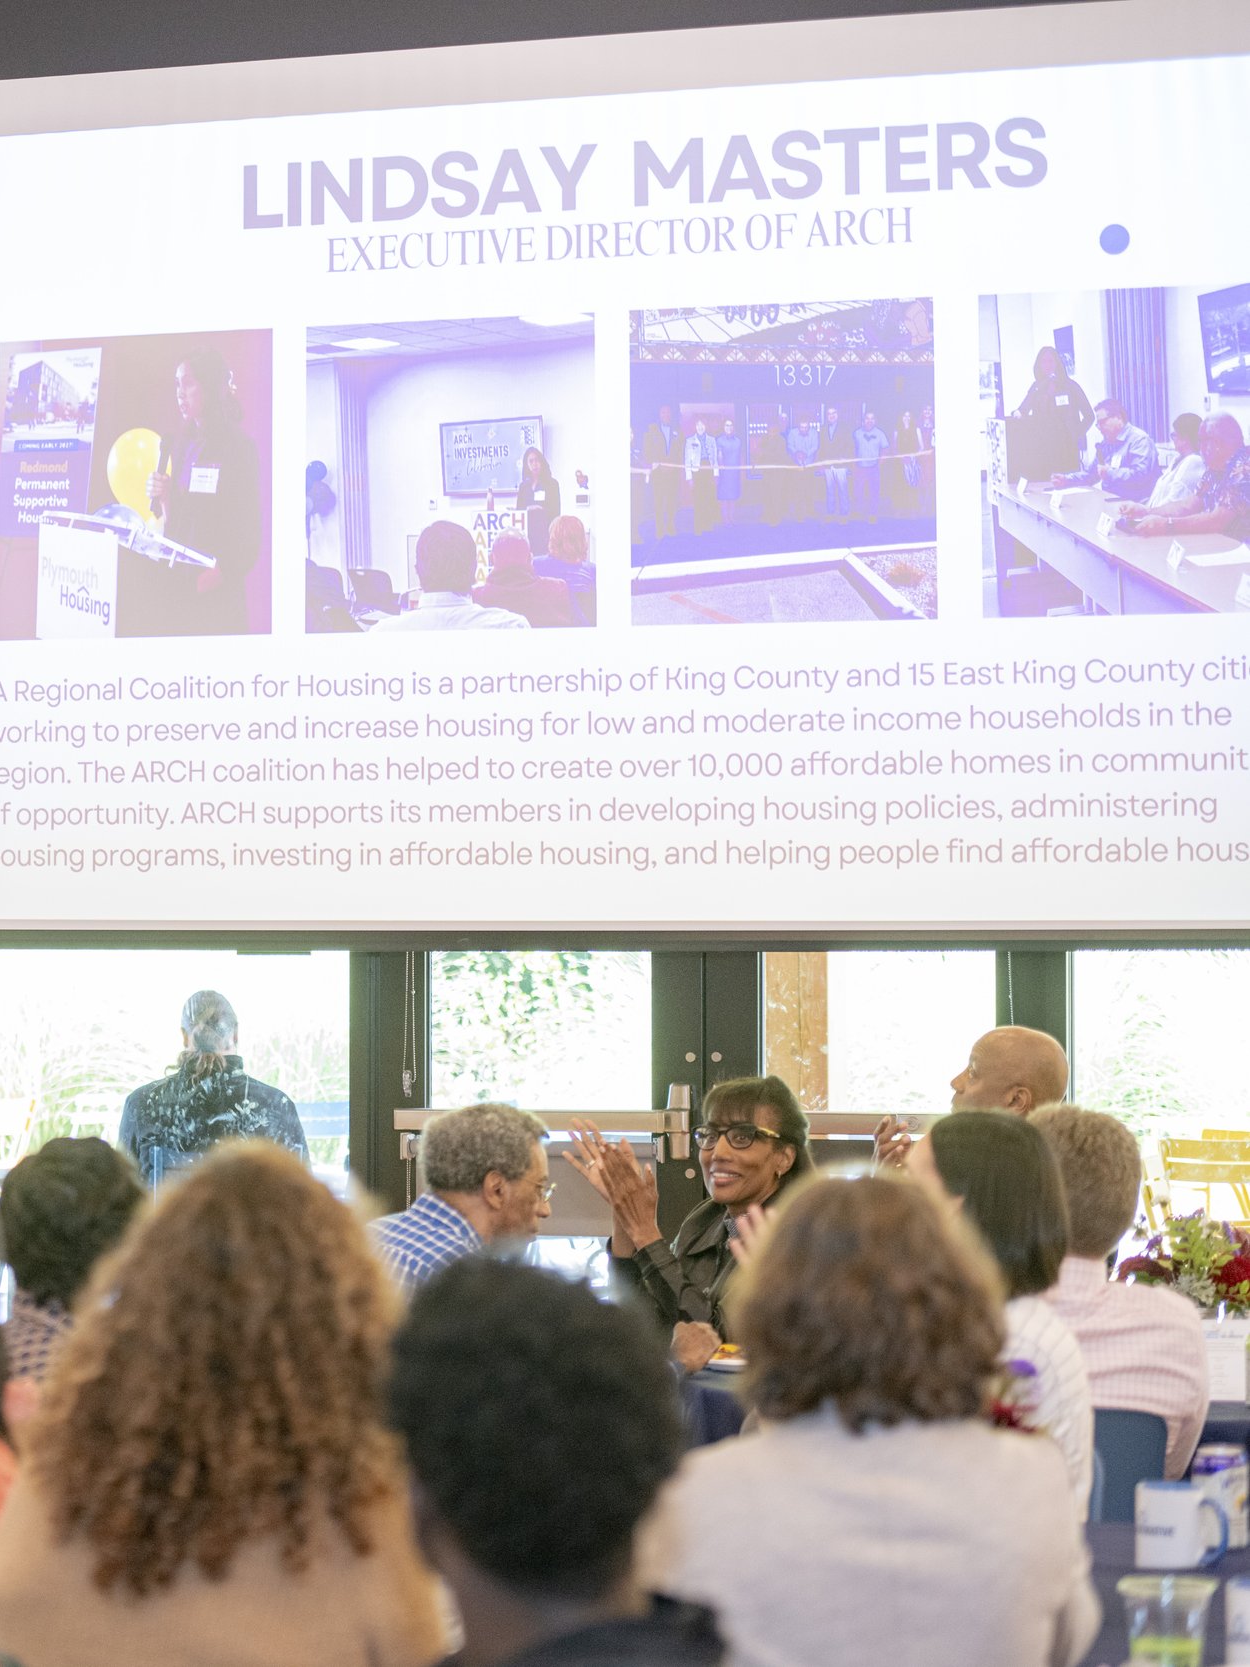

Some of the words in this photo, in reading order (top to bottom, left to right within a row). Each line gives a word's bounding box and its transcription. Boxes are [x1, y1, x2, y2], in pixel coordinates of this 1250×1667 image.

[243, 143, 598, 229] LINDSAY
[634, 117, 1048, 208] MASTERS
[326, 227, 537, 273] EXECUTIVE
[545, 216, 737, 262] DIRECTOR
[745, 213, 798, 251] OF
[806, 207, 914, 248] ARCH
[774, 364, 836, 387] 13317
[454, 434, 472, 445] ARCH
[454, 445, 509, 459] INVESTMENTS
[15, 477, 70, 490] Permanent
[20, 459, 68, 473] Redmond
[13, 494, 68, 509] Supportive
[473, 512, 526, 531] ARCH
[41, 556, 99, 590] Plymouth
[60, 584, 111, 626] Housing
[15, 677, 122, 708] Regional
[129, 675, 244, 700] Coalition
[251, 674, 290, 698] for
[297, 672, 404, 702] Housing
[412, 671, 431, 695] is
[439, 676, 453, 695] a
[462, 667, 622, 700] partnership
[629, 666, 659, 691] of
[666, 666, 725, 696] King
[734, 665, 839, 694] County
[846, 662, 900, 688] and
[908, 663, 935, 686] 15
[944, 662, 1004, 686] East
[1013, 659, 1076, 690] King
[1084, 658, 1195, 688] County
[92, 722, 119, 742] to
[127, 722, 241, 747] preserve
[247, 715, 297, 740] and
[305, 716, 419, 739] increase
[426, 712, 533, 743] housing
[540, 711, 580, 736] for
[588, 710, 635, 735] low
[642, 709, 694, 735] and
[703, 708, 845, 733] moderate
[853, 707, 962, 731] income
[970, 702, 1141, 730] households
[1149, 702, 1173, 726] in
[1181, 701, 1232, 726] the
[78, 760, 125, 784] The
[131, 760, 205, 783] ARCH
[213, 758, 325, 783] coalition
[333, 757, 379, 781] has
[386, 755, 479, 786] helped
[486, 758, 515, 780] to
[522, 757, 613, 779] create
[619, 759, 681, 778] over
[688, 752, 783, 780] 10,000
[791, 750, 943, 776] affordable
[951, 749, 1051, 774] homes
[1059, 748, 1083, 772] in
[16, 801, 174, 831] opportunity.
[181, 801, 255, 824] ARCH
[263, 802, 383, 829] supports
[390, 799, 421, 823] its
[429, 798, 561, 823] members
[569, 797, 591, 821] in
[599, 796, 755, 827] developing
[764, 795, 876, 826] housing
[886, 794, 1003, 825] policies,
[1011, 791, 1217, 823] administering
[92, 848, 226, 873] programs,
[233, 842, 351, 872] investing
[360, 842, 381, 865] in
[389, 841, 533, 866] affordable
[540, 841, 657, 871] housing,
[665, 840, 717, 865] and
[726, 839, 830, 871] helping
[840, 838, 939, 870] people
[946, 838, 1003, 863] find
[1011, 836, 1168, 863] affordable
